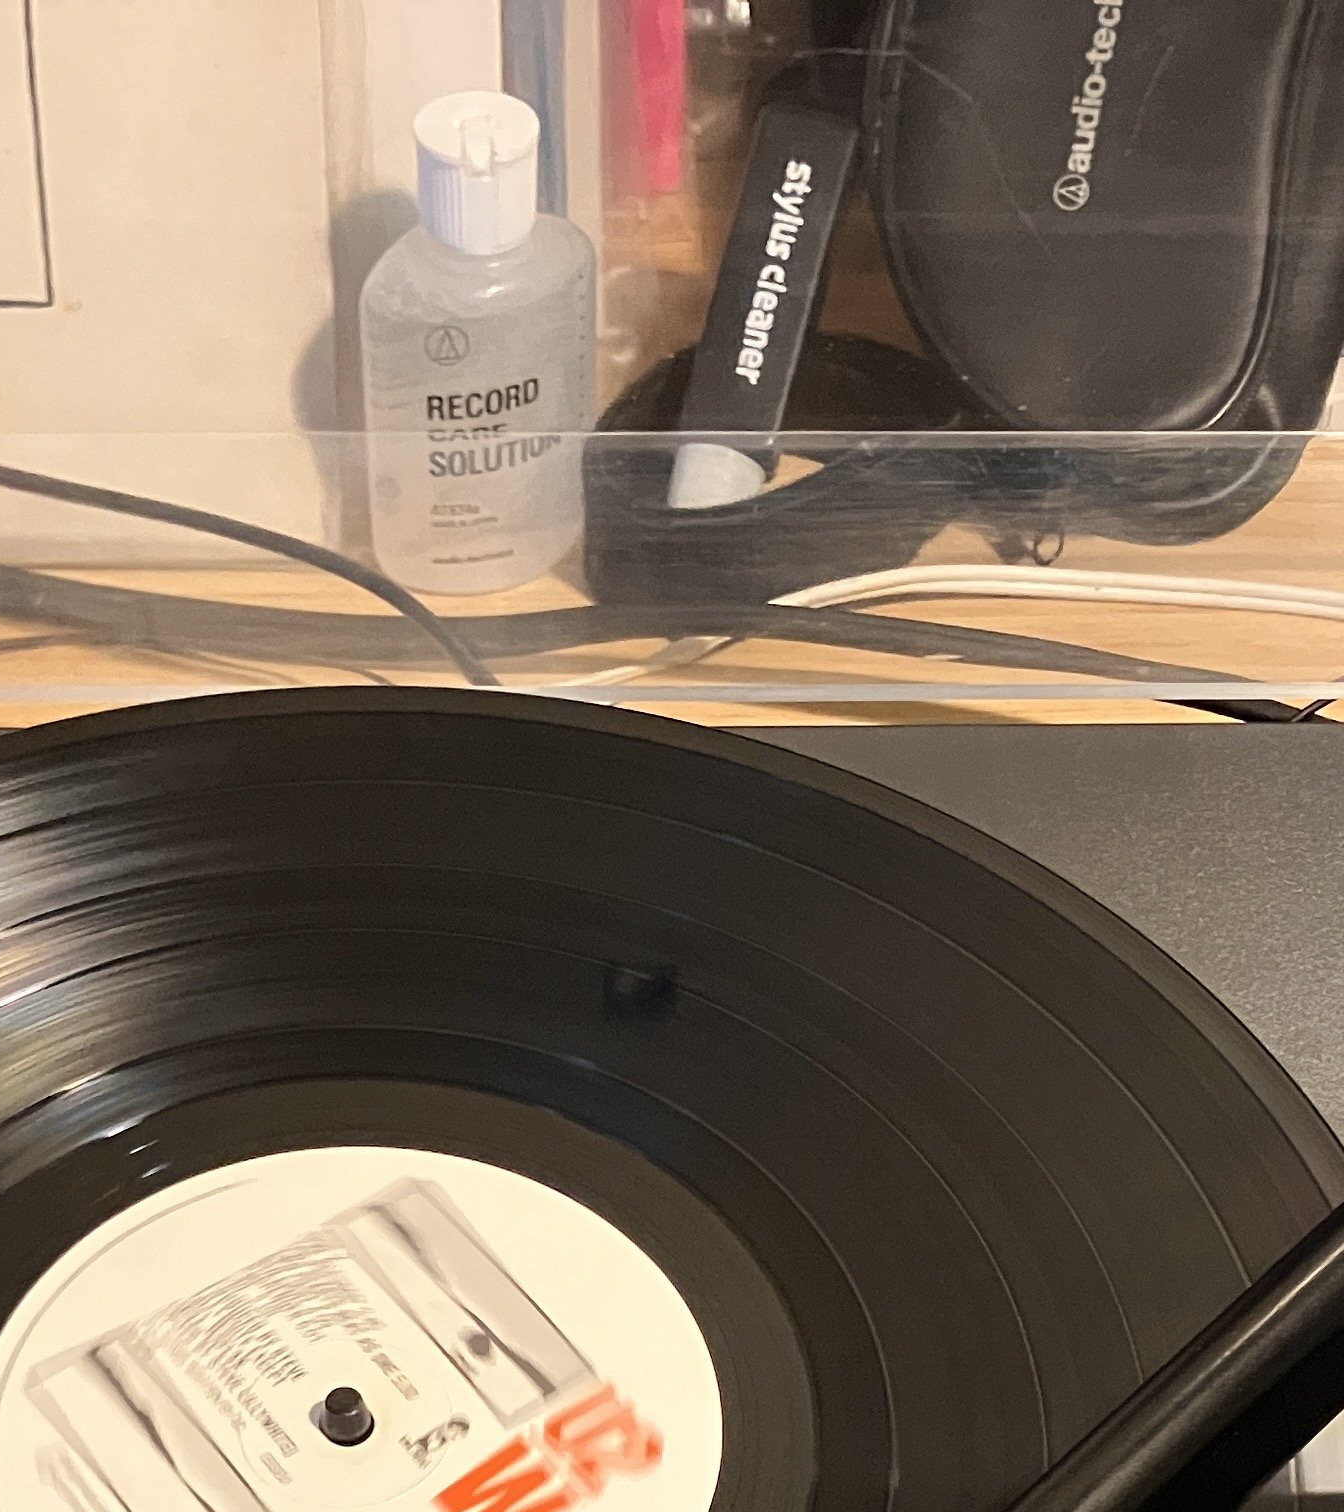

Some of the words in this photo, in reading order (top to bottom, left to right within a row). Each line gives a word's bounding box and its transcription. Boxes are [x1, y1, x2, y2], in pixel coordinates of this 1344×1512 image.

[765, 160, 812, 261] stylus
[735, 264, 788, 386] cleaner
[426, 378, 539, 421] RECORD
[428, 423, 508, 442] CARE
[429, 434, 561, 478] SOLUTION
